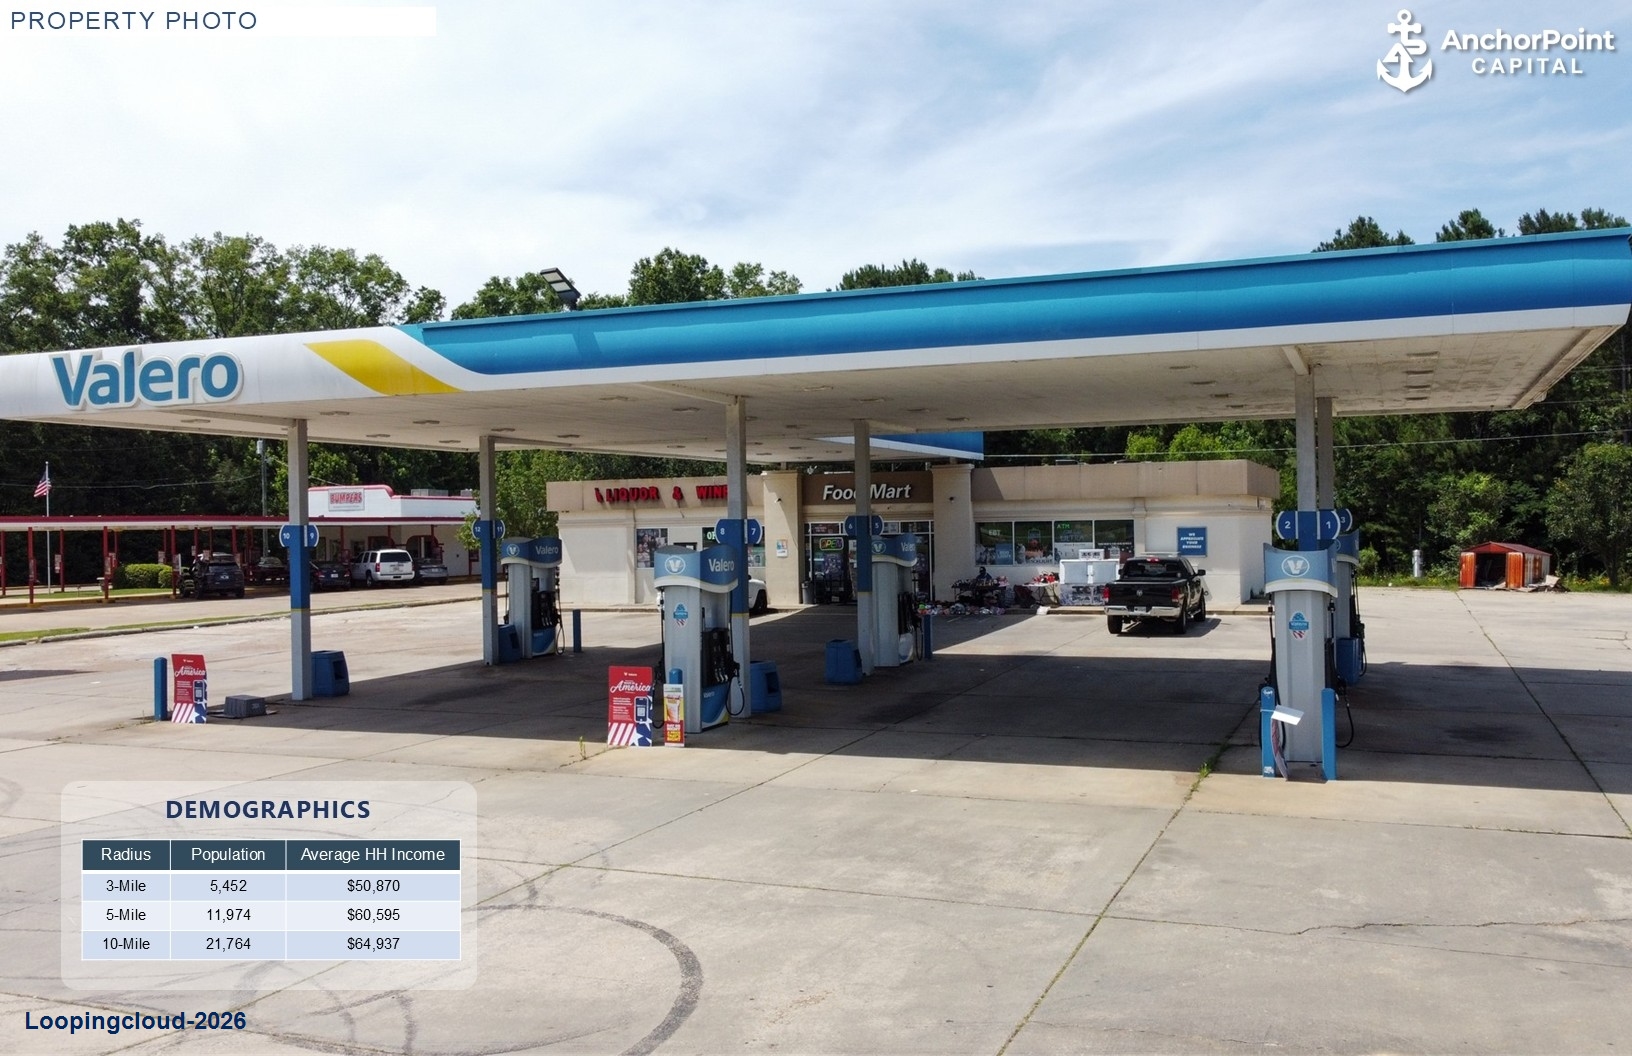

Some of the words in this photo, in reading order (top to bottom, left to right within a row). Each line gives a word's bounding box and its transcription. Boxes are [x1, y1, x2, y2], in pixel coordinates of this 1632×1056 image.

[51, 349, 241, 408] Valero
[605, 486, 660, 503] LIQUOR
[672, 486, 684, 500] &
[822, 484, 857, 501] Foo
[869, 483, 912, 499] Mart
[330, 492, 363, 505] BUMPERS
[1284, 521, 1291, 529] 2
[1325, 521, 1331, 529] 1
[1340, 516, 1346, 524] 3
[282, 532, 291, 540] 10
[309, 532, 315, 540] 9
[820, 539, 842, 548] OPEN
[535, 545, 559, 555] Valero
[708, 558, 735, 573] Valero
[174, 665, 206, 678] America
[609, 680, 651, 694] America
